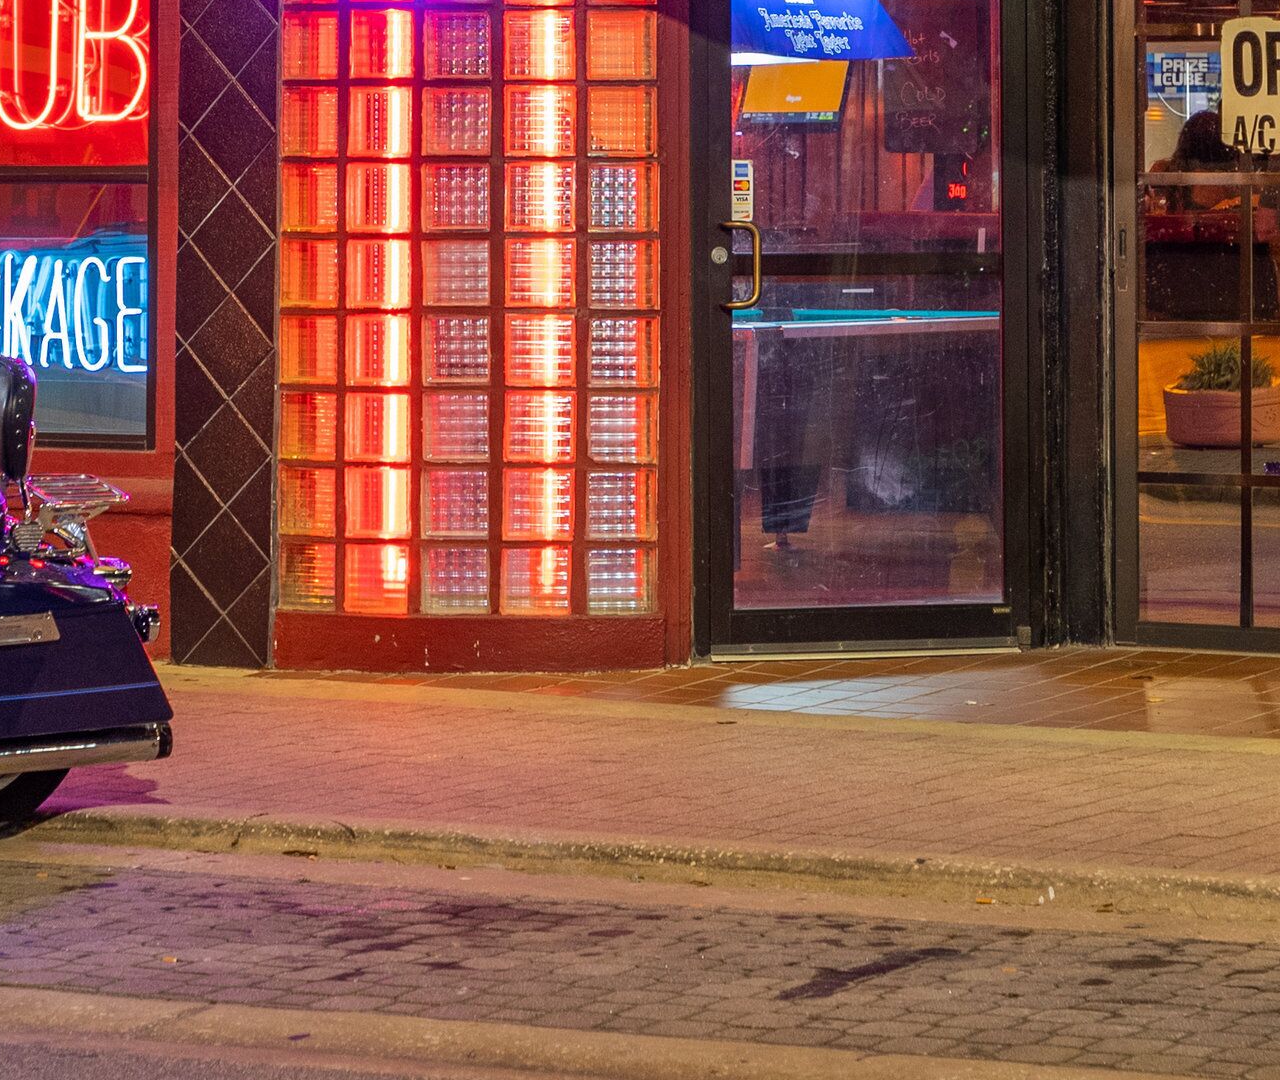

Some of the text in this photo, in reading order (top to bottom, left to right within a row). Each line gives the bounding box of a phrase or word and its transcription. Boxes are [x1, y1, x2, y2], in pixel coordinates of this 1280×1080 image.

[1162, 58, 1209, 72] PRIZE
[1162, 72, 1204, 86] CUBE
[1233, 114, 1277, 152] A/C
